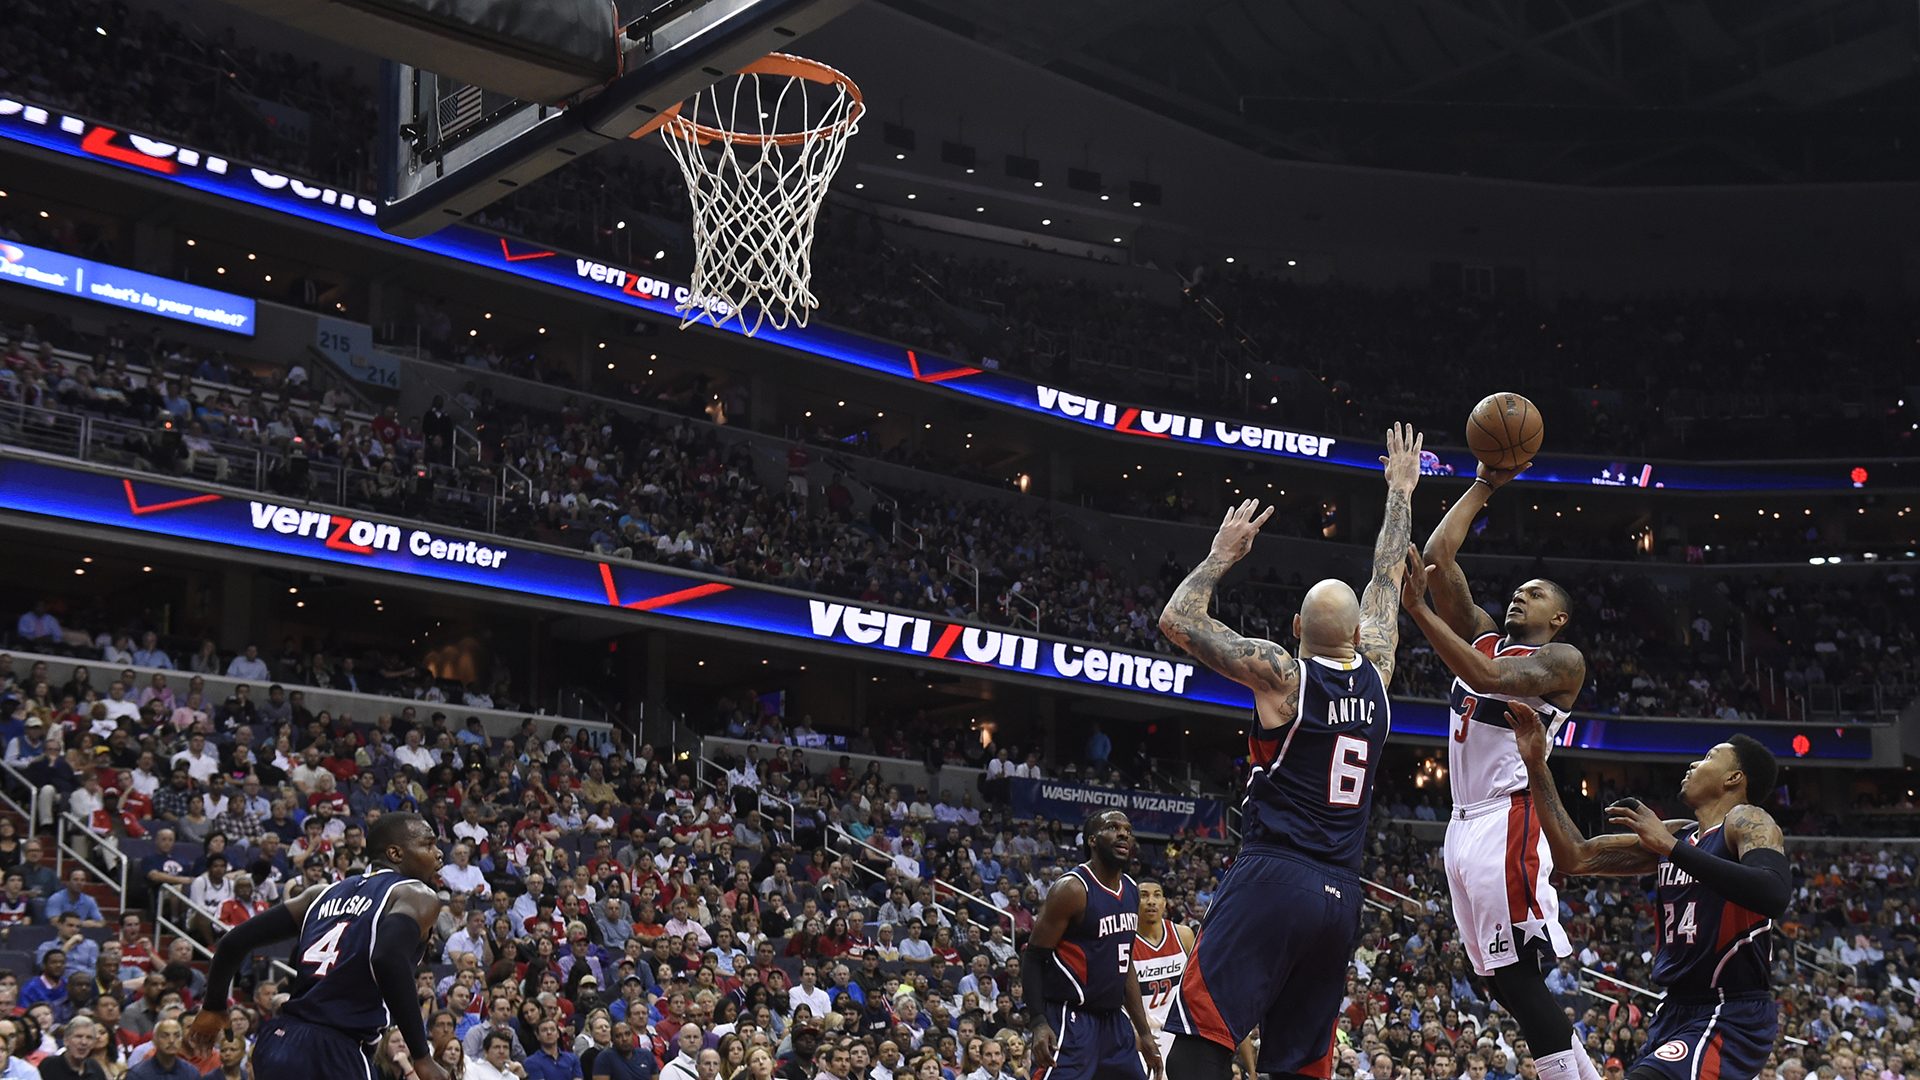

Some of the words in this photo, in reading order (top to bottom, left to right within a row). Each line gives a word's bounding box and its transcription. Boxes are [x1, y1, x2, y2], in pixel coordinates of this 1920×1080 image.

[576, 258, 670, 300] verizon
[91, 283, 141, 304] what's
[141, 292, 158, 307] in
[157, 298, 193, 317] your
[193, 307, 246, 328] wallet?
[320, 331, 350, 352] 215
[367, 366, 397, 387] 214
[250, 501, 401, 555] verizon
[409, 530, 507, 569] Center
[1053, 642, 1194, 695] Center
[1328, 697, 1375, 725] ANTIC
[1455, 696, 1477, 743] 3
[1327, 733, 1370, 808] 6
[1042, 785, 1128, 808] WASHINGTON
[1133, 796, 1196, 815] WIZARDS
[1663, 900, 1698, 945] 24
[301, 920, 351, 978] 4
[1118, 942, 1131, 974] 5
[1137, 960, 1182, 978] wizards
[1149, 979, 1171, 1009] 22
